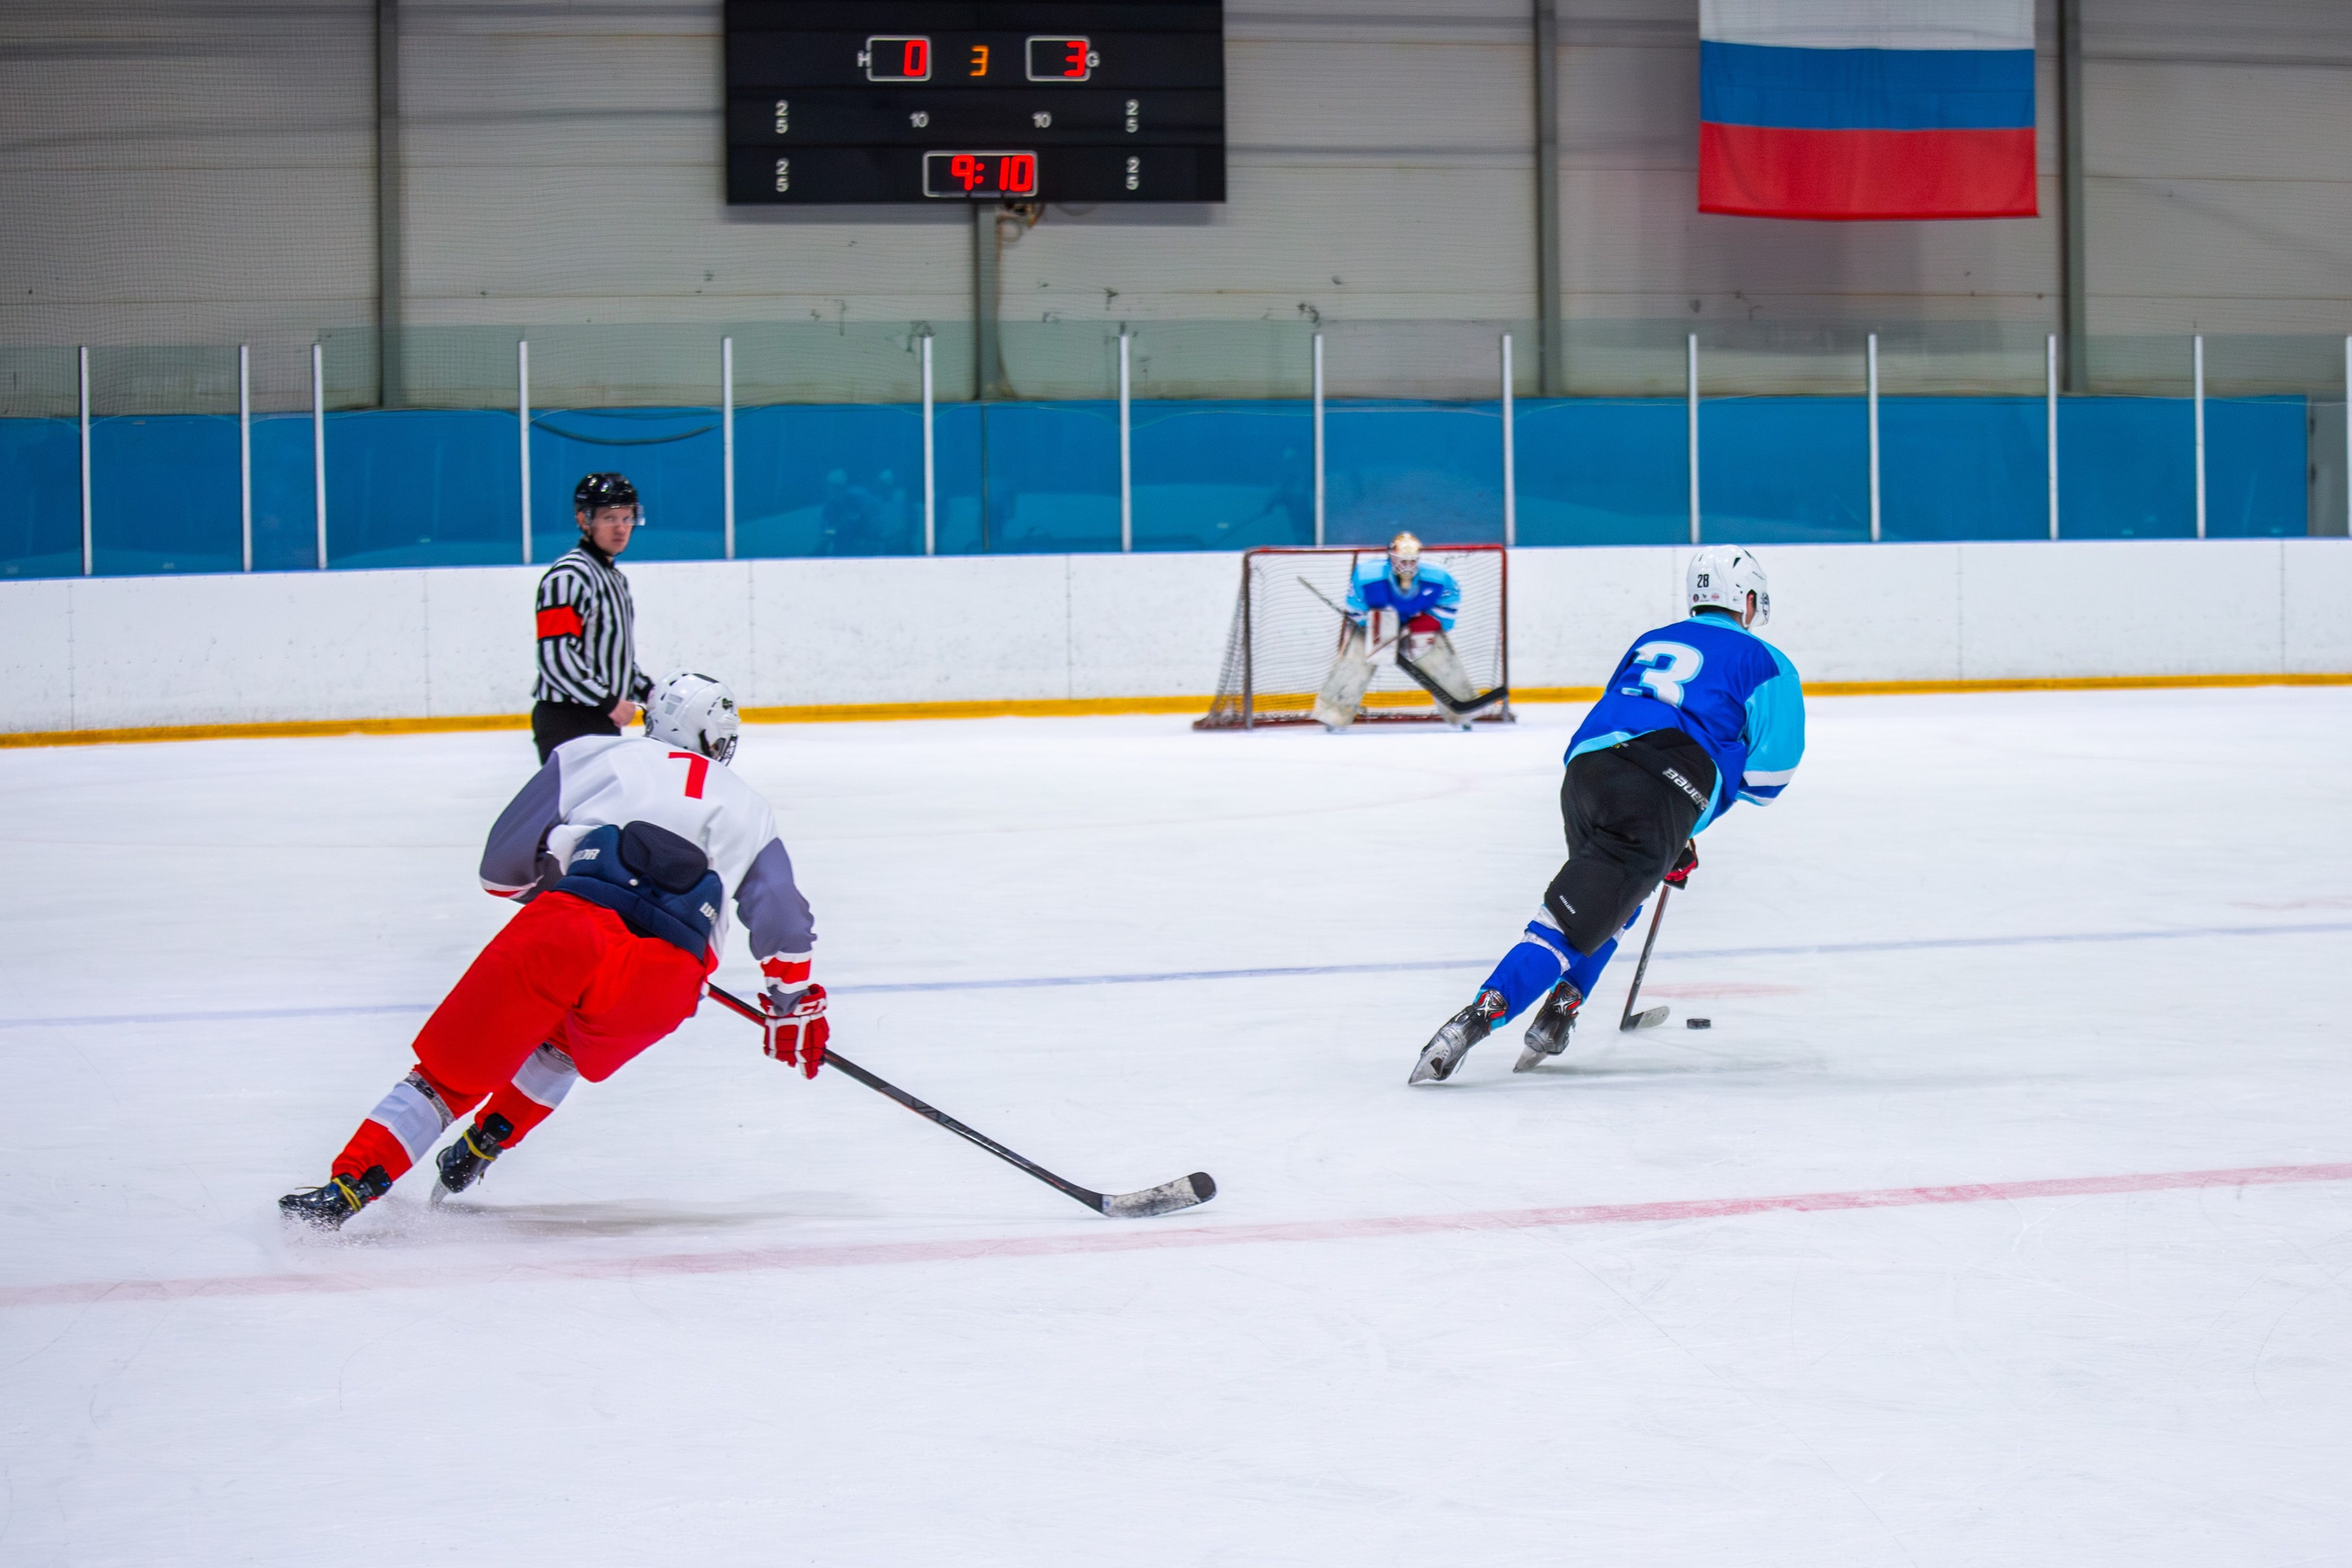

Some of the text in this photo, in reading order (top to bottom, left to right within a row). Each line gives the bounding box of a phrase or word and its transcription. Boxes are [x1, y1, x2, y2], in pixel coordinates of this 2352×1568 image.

[857, 39, 1101, 78] H 0 3 3 G
[775, 100, 788, 117] 2
[1125, 99, 1139, 116] 2
[775, 117, 788, 134] 5
[910, 111, 929, 128] 10
[1032, 112, 1052, 129] 10
[1125, 117, 1138, 133] 5
[775, 159, 789, 175] 2
[1126, 157, 1140, 174] 2
[775, 175, 789, 192] 5
[1125, 175, 1139, 190] 5
[1697, 573, 1710, 589] 28
[1621, 640, 1704, 708] 3
[667, 750, 710, 801] 7
[1662, 767, 1710, 811] BAUER
